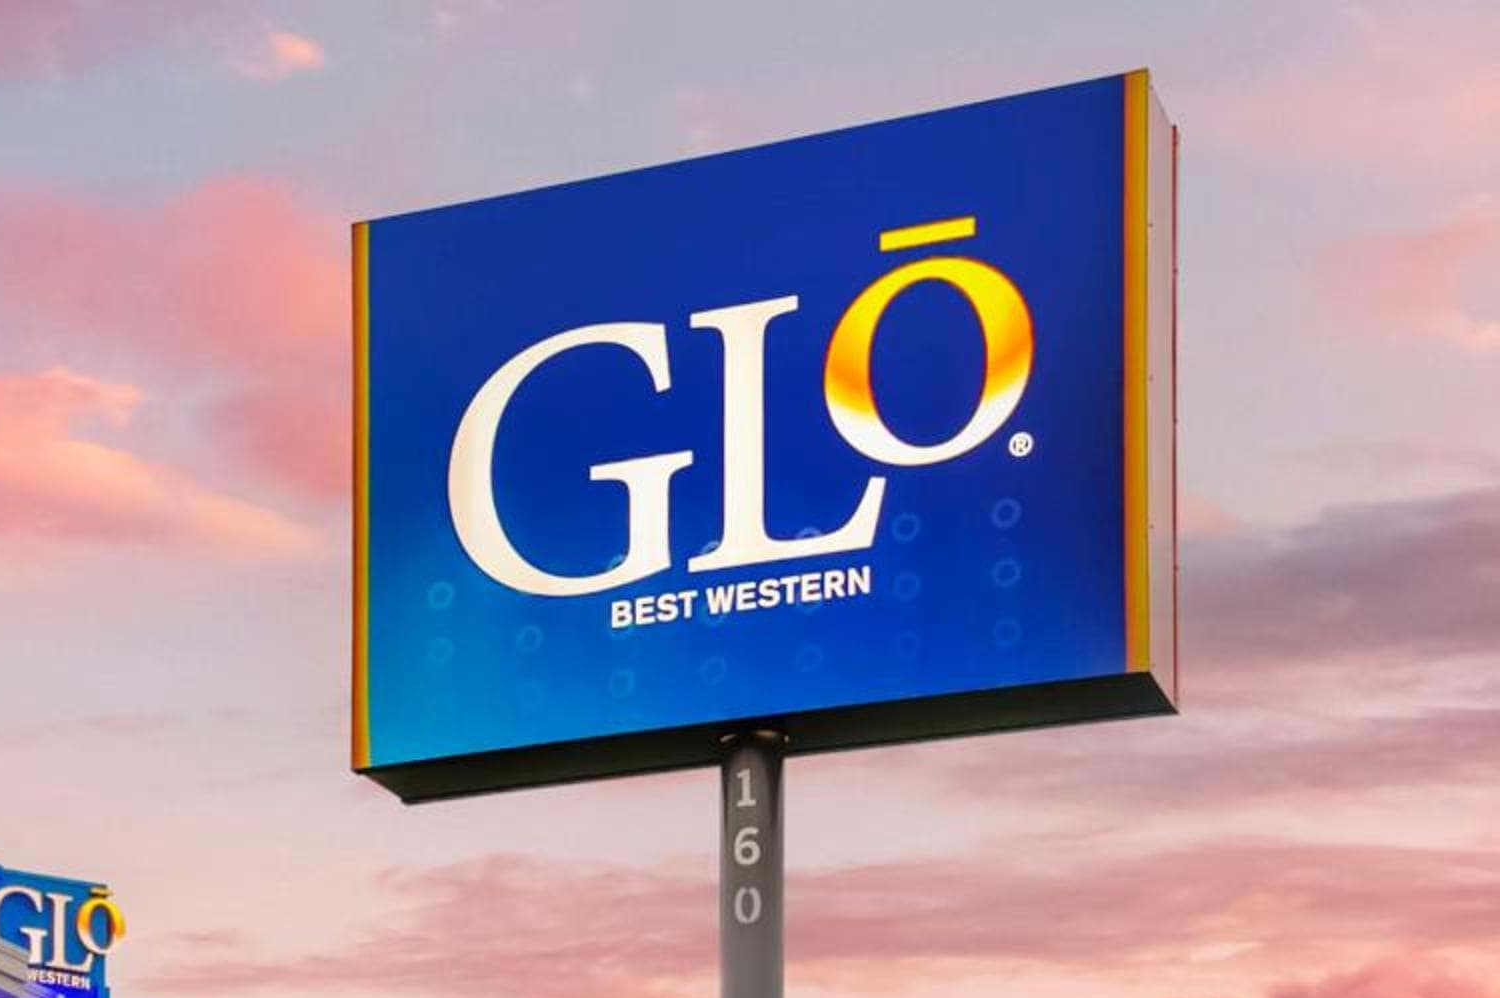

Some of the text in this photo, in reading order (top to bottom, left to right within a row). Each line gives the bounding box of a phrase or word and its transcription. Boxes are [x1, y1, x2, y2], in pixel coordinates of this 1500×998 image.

[611, 565, 871, 629] BEST WESTERN
[733, 767, 762, 924] 160
